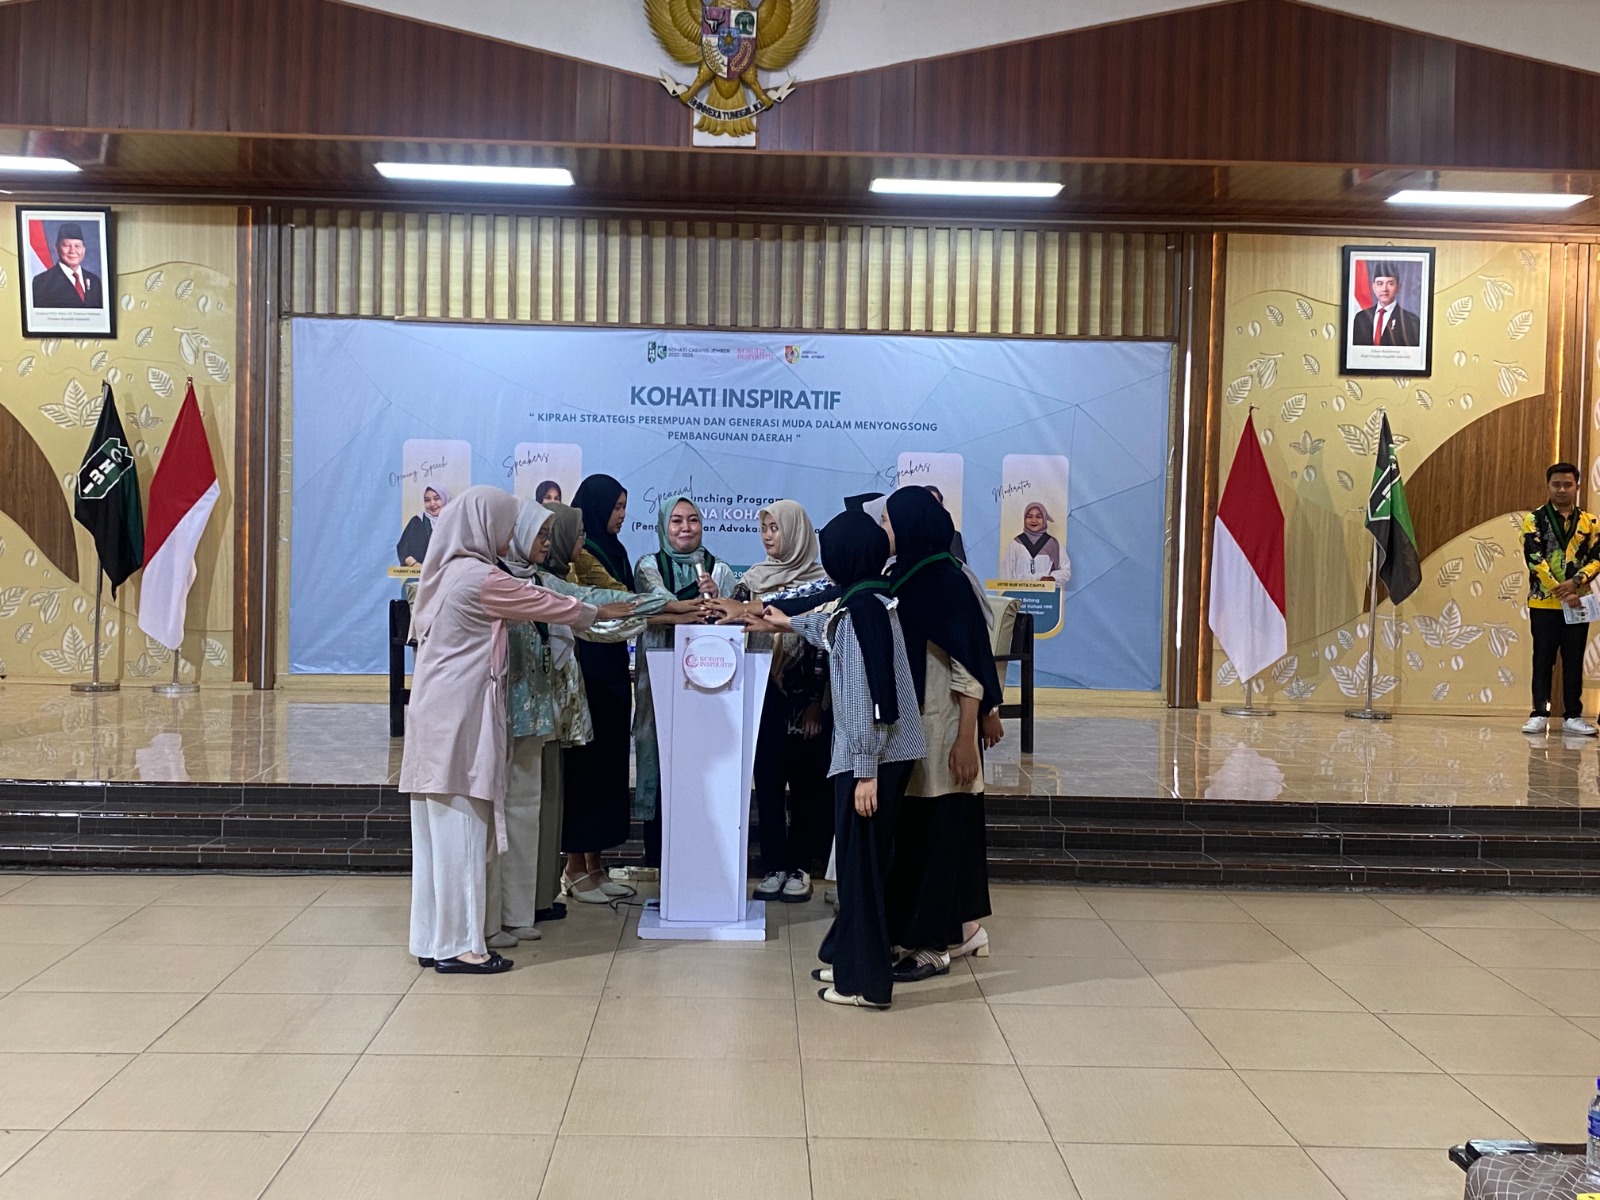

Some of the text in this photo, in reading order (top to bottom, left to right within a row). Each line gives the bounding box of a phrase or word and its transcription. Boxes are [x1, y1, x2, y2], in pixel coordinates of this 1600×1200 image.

[630, 386, 841, 410] KOHATI INSPIRATIF
[537, 413, 577, 422] KIPRAH
[579, 414, 635, 424] STRATEGIS
[638, 415, 701, 426] PEREMPUAN
[703, 417, 726, 426] DAN
[729, 418, 780, 428] GENERASI
[782, 420, 813, 429] MUDA
[815, 420, 852, 430] DALAM
[854, 421, 938, 432] MENYONGSONG
[667, 431, 749, 441] PEMBANGUNAN
[751, 433, 793, 442] DAERAH
[388, 455, 447, 488] Opening Speech
[502, 449, 549, 477] Speakers
[884, 459, 930, 487] Speakers
[991, 479, 1031, 503] Moderator
[699, 508, 760, 520] NA KOHA
[631, 521, 659, 533] (Peng
[718, 524, 759, 533] Advoka
